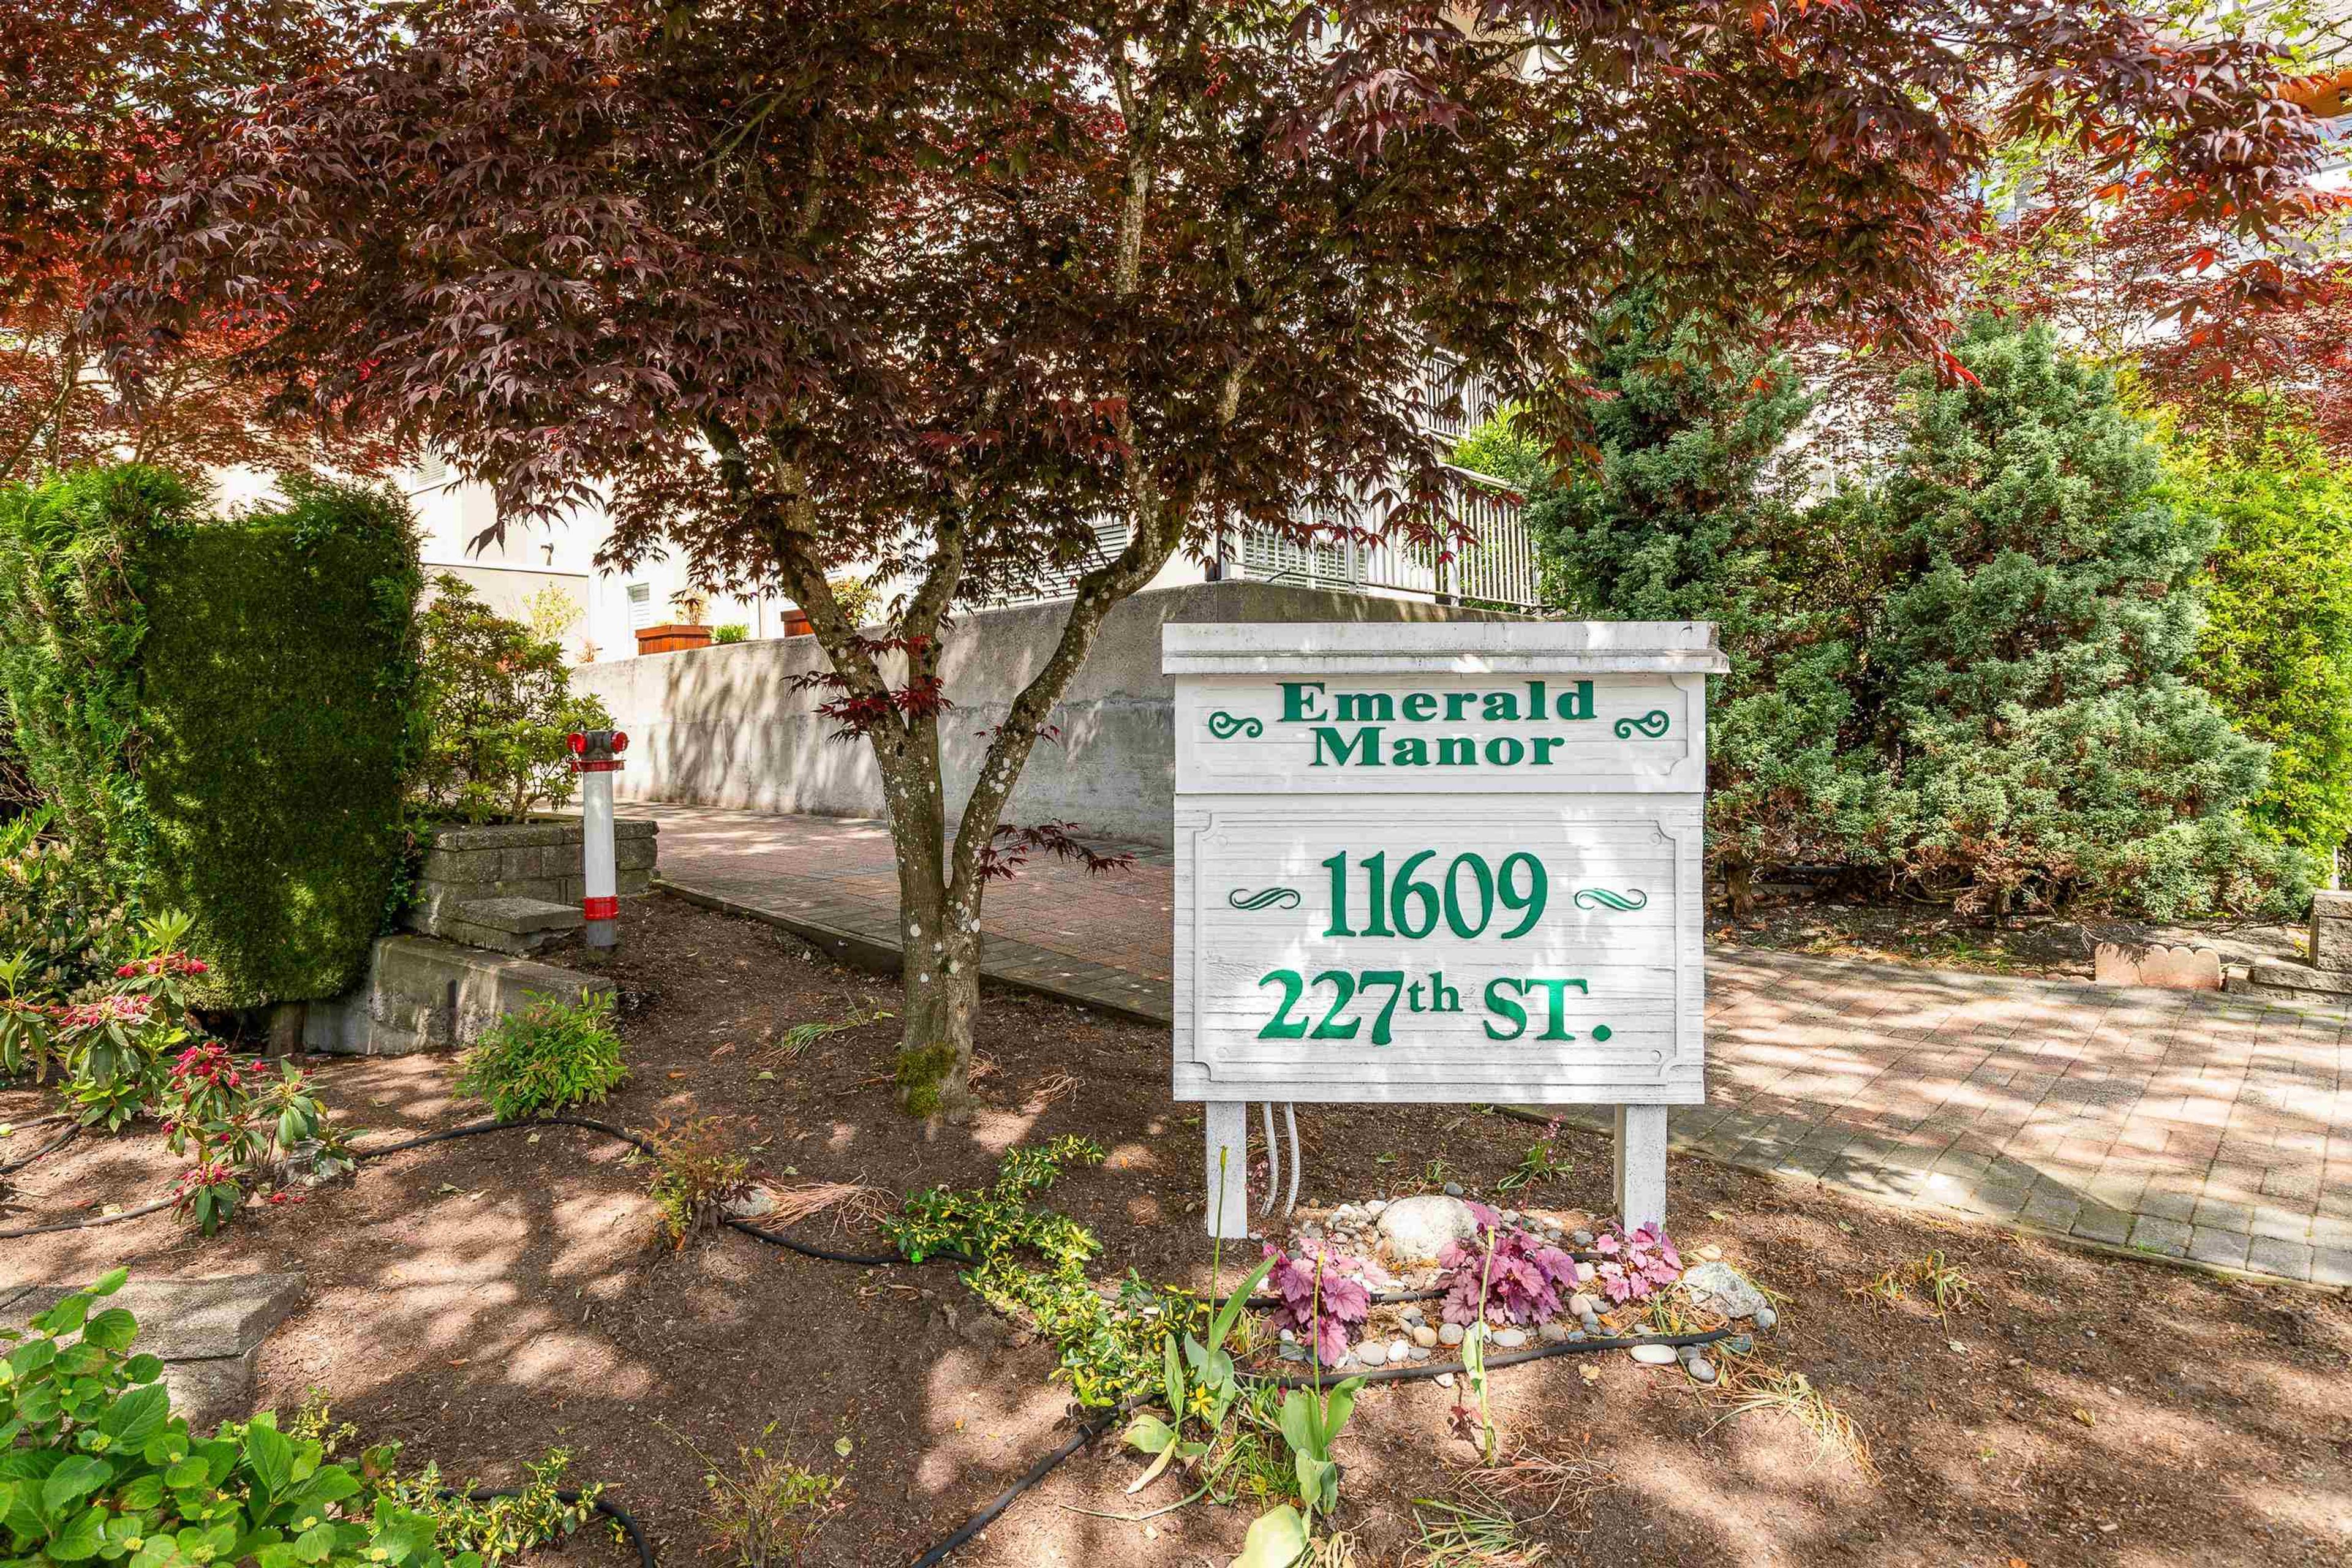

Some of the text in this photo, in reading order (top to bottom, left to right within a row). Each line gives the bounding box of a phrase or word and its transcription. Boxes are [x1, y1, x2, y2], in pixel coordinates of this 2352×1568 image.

[1276, 680, 1598, 723] Emerald
[1308, 726, 1566, 767] Manor
[1321, 849, 1549, 940] 11609
[1256, 968, 1613, 1046] 227th ST.
